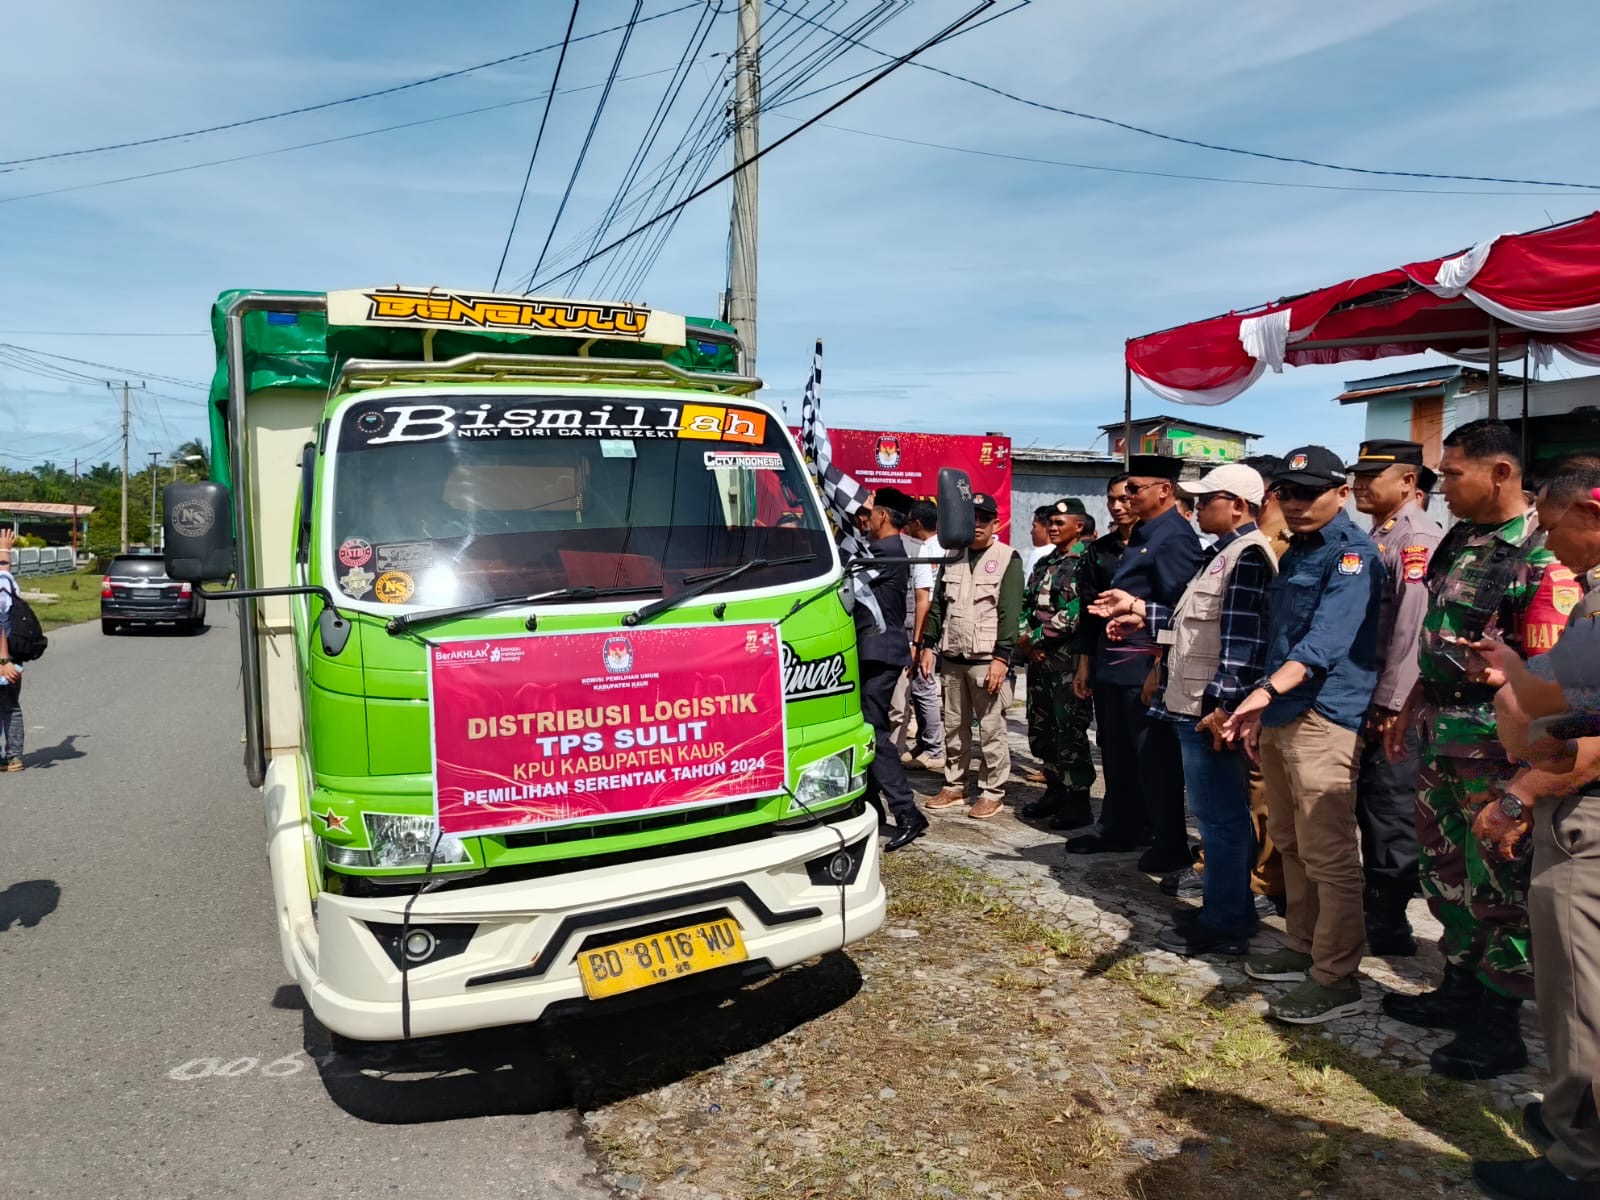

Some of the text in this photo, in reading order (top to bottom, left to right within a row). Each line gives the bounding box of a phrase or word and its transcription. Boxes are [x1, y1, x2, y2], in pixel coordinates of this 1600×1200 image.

[371, 294, 648, 333] BENGKULU
[457, 428, 675, 438] NIAT DIRI CARI REZEKI
[181, 508, 206, 526] NS
[385, 580, 408, 597] NS
[435, 645, 489, 660] BerAKHLAK
[581, 676, 604, 684] KOMISI
[605, 674, 640, 682] PEMILIHAN
[593, 680, 649, 691] KABUPATEN KAUR
[467, 692, 758, 740] DISTRIBUSI LOGISTIK
[535, 721, 708, 757] TPS SULIT
[513, 741, 725, 781] KPU KABUPATEN KAUR
[463, 757, 766, 806] PEMILIHAN SERENTAK TAHUN 2024
[588, 922, 735, 982] BD 8116 WU
